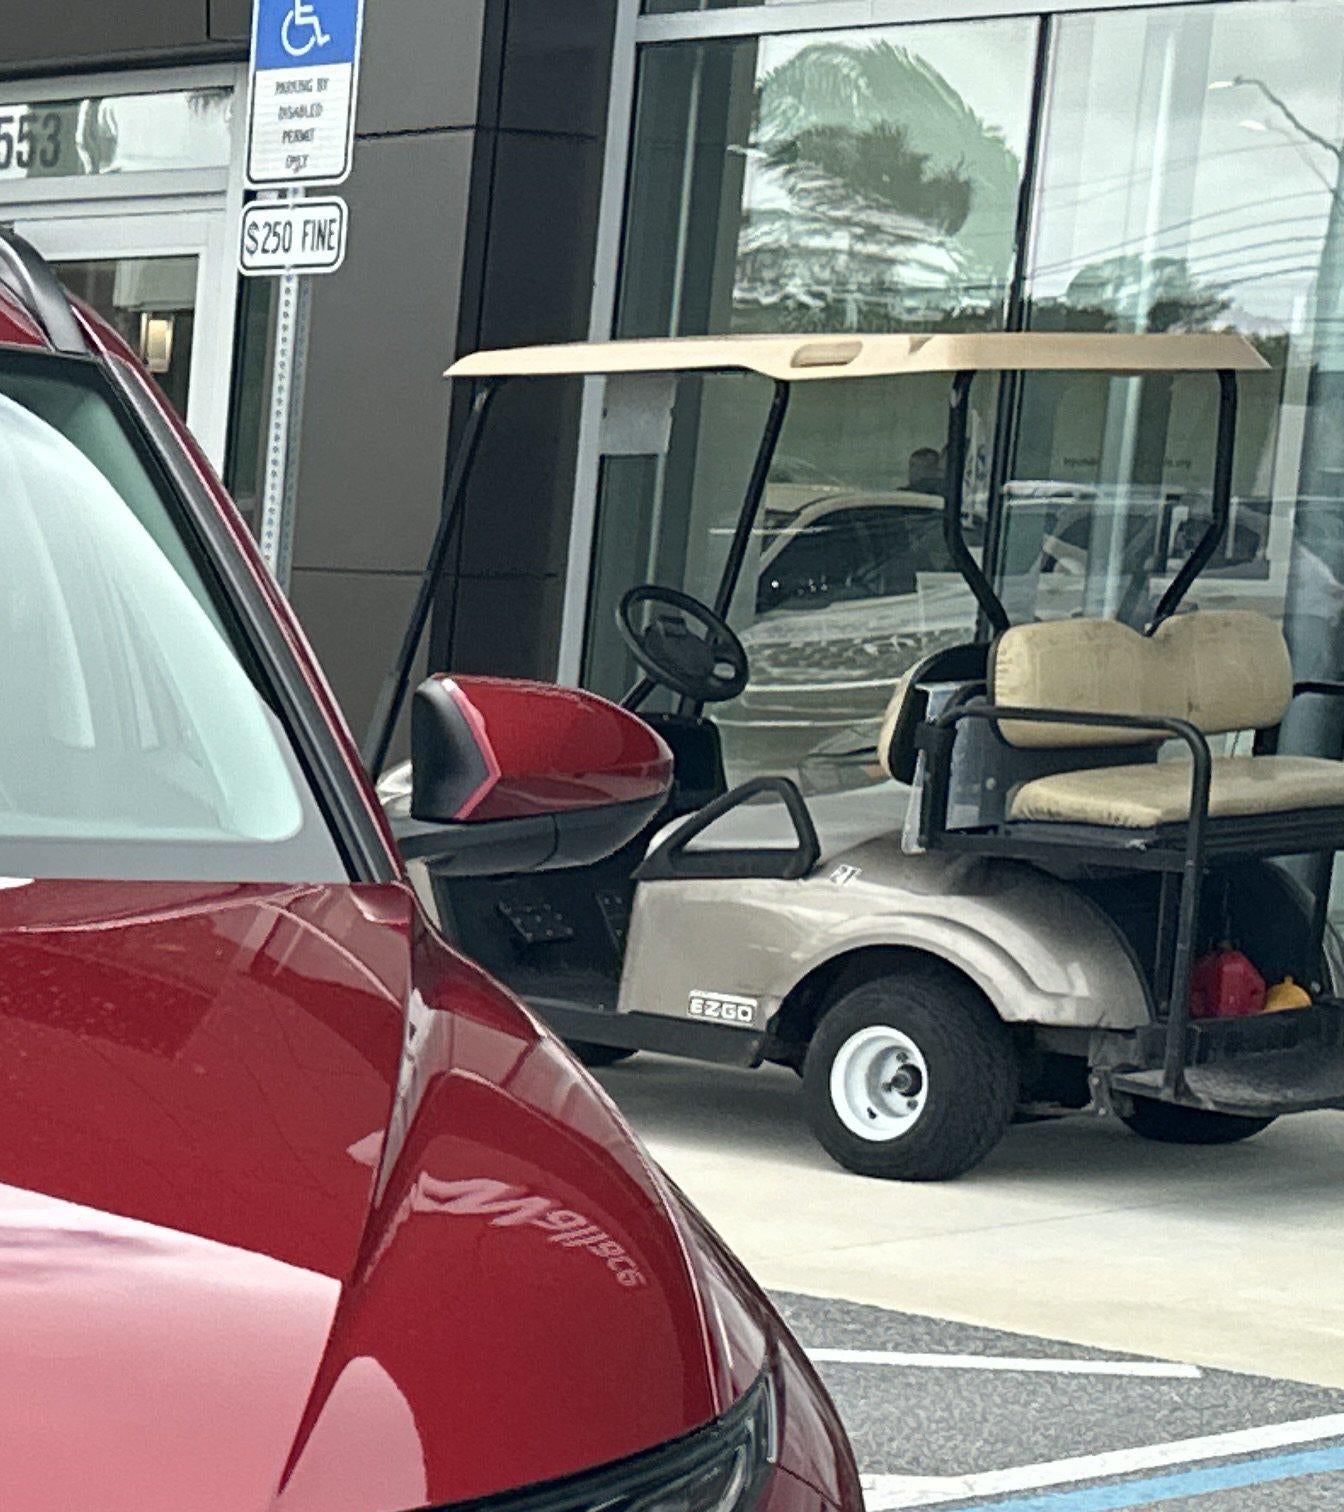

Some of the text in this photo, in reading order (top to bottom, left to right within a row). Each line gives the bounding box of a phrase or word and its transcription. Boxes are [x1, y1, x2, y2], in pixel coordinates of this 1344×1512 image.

[274, 78, 329, 95] PARKING BY
[277, 102, 323, 120] DISABLED
[281, 127, 315, 144] PERMIT
[246, 218, 337, 256] $250 FINE
[689, 998, 753, 1023] EZGO
